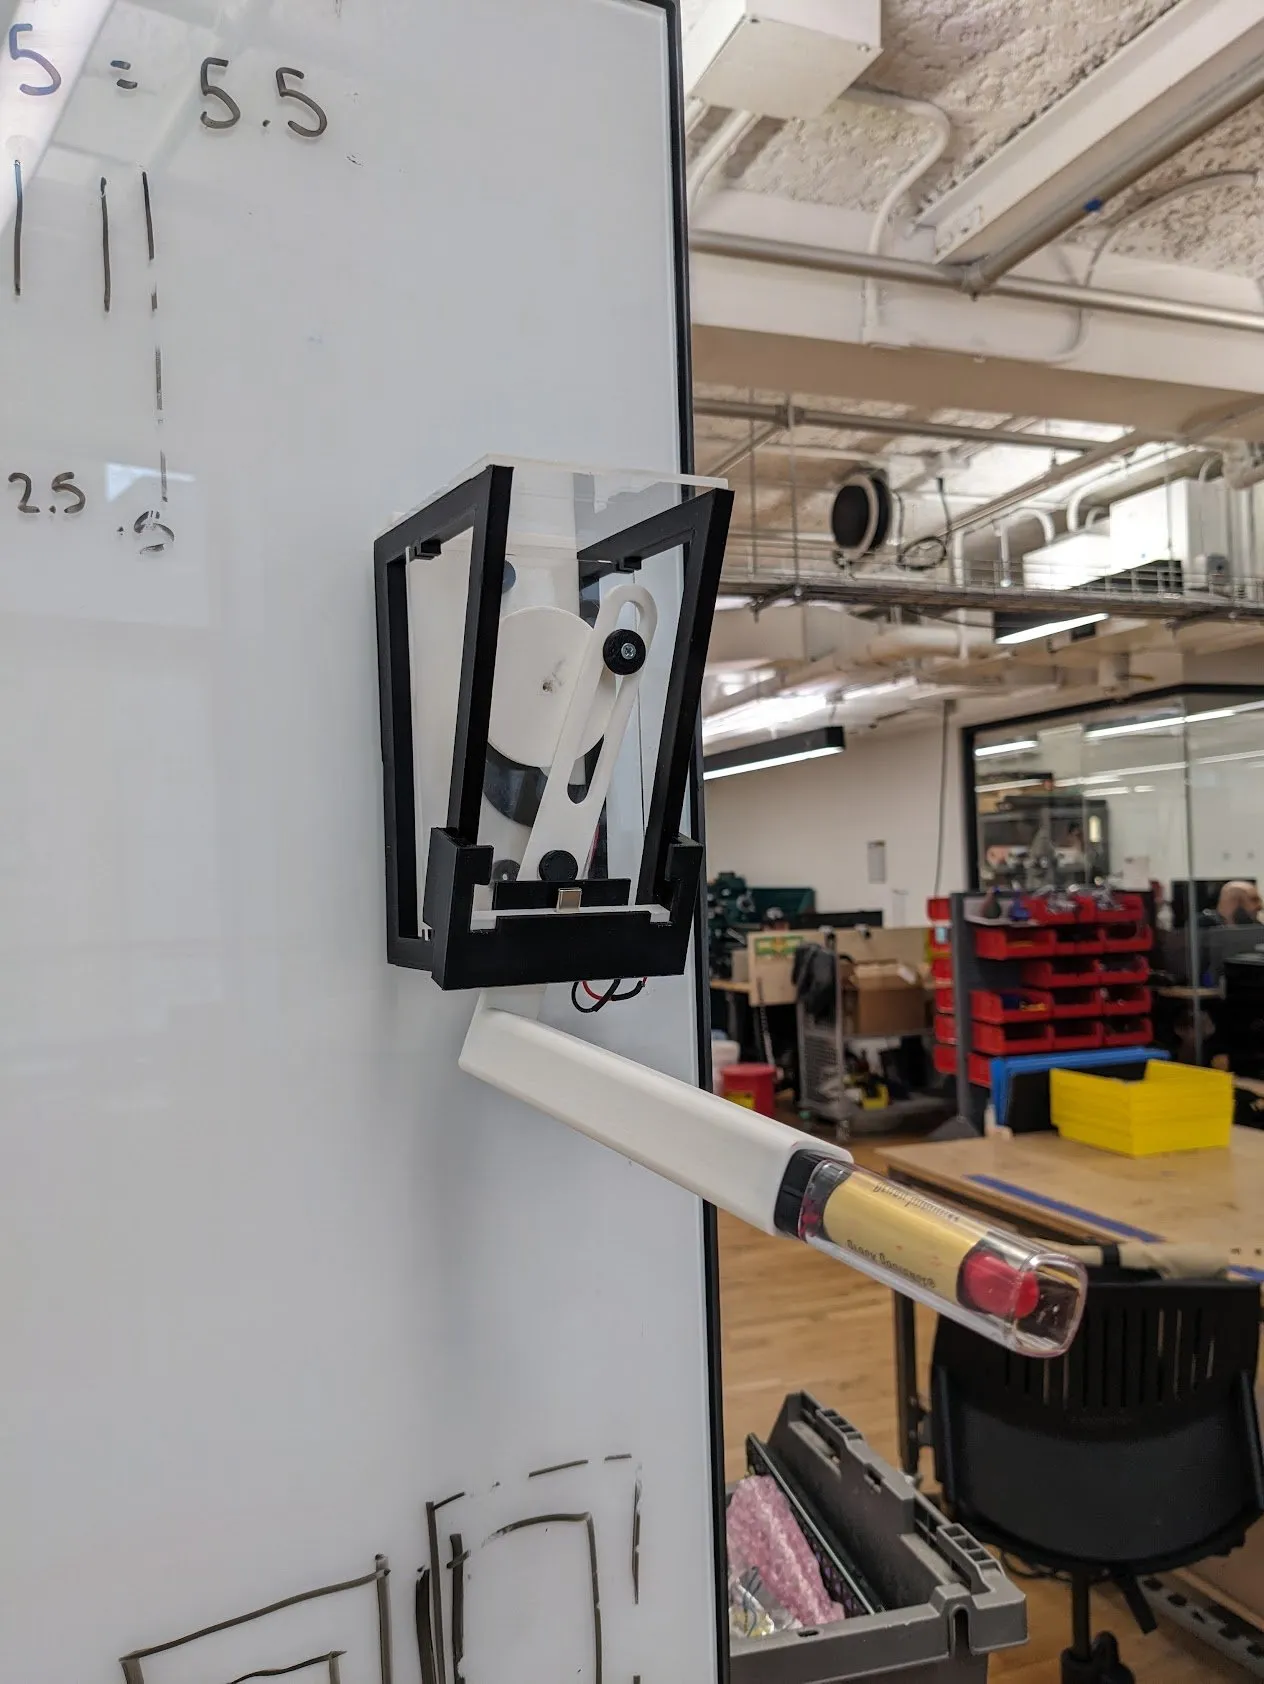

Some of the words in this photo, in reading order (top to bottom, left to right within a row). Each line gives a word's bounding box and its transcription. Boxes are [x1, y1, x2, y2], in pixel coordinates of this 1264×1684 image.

[9, 23, 61, 96] 5
[200, 57, 327, 138] 5.5
[8, 472, 86, 514] 2.5
